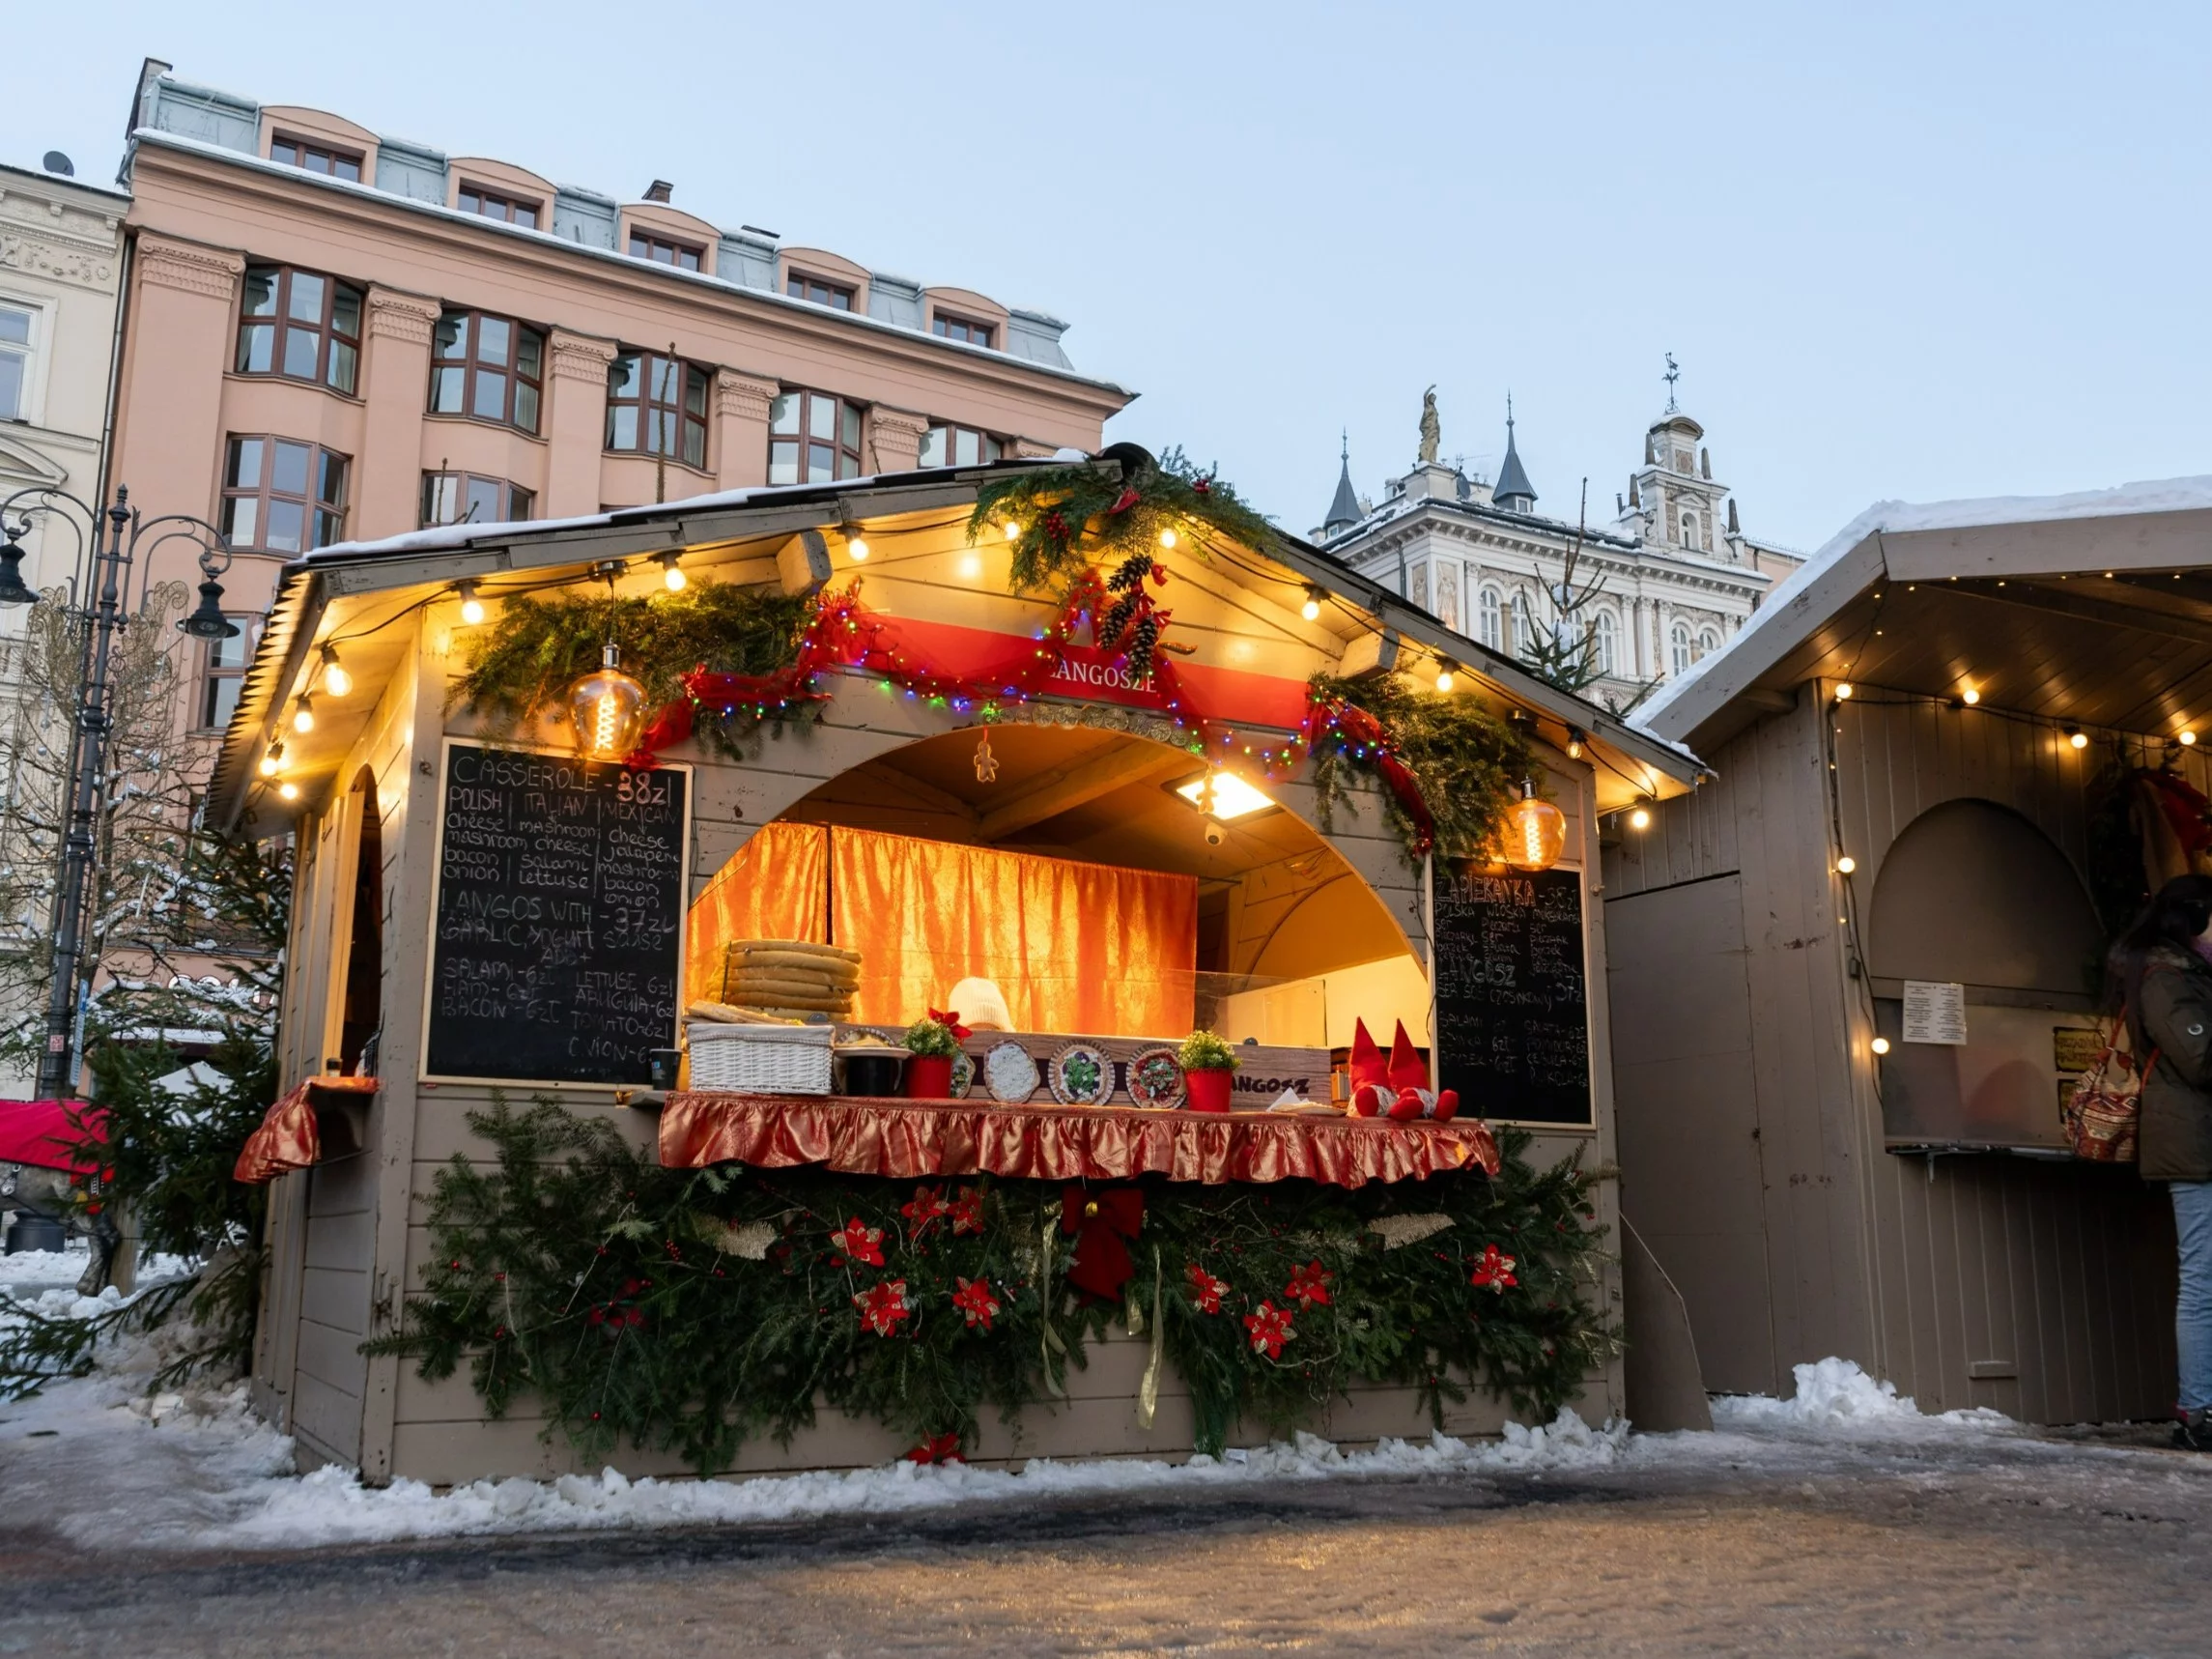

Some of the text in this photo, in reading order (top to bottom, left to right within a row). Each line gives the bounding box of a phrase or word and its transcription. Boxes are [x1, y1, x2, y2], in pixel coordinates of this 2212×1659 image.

[1049, 659, 1157, 693] ANGOSZE
[454, 756, 601, 791] CASSEROLE
[448, 785, 503, 812] POLISH
[524, 791, 589, 816] ITALIAN
[601, 801, 679, 825] MEXICAN
[534, 834, 594, 857] cheese
[609, 824, 670, 848] cheese
[444, 844, 500, 866] bacon
[604, 874, 660, 895] bacon
[604, 893, 660, 909] onion
[441, 995, 507, 1019] BACON
